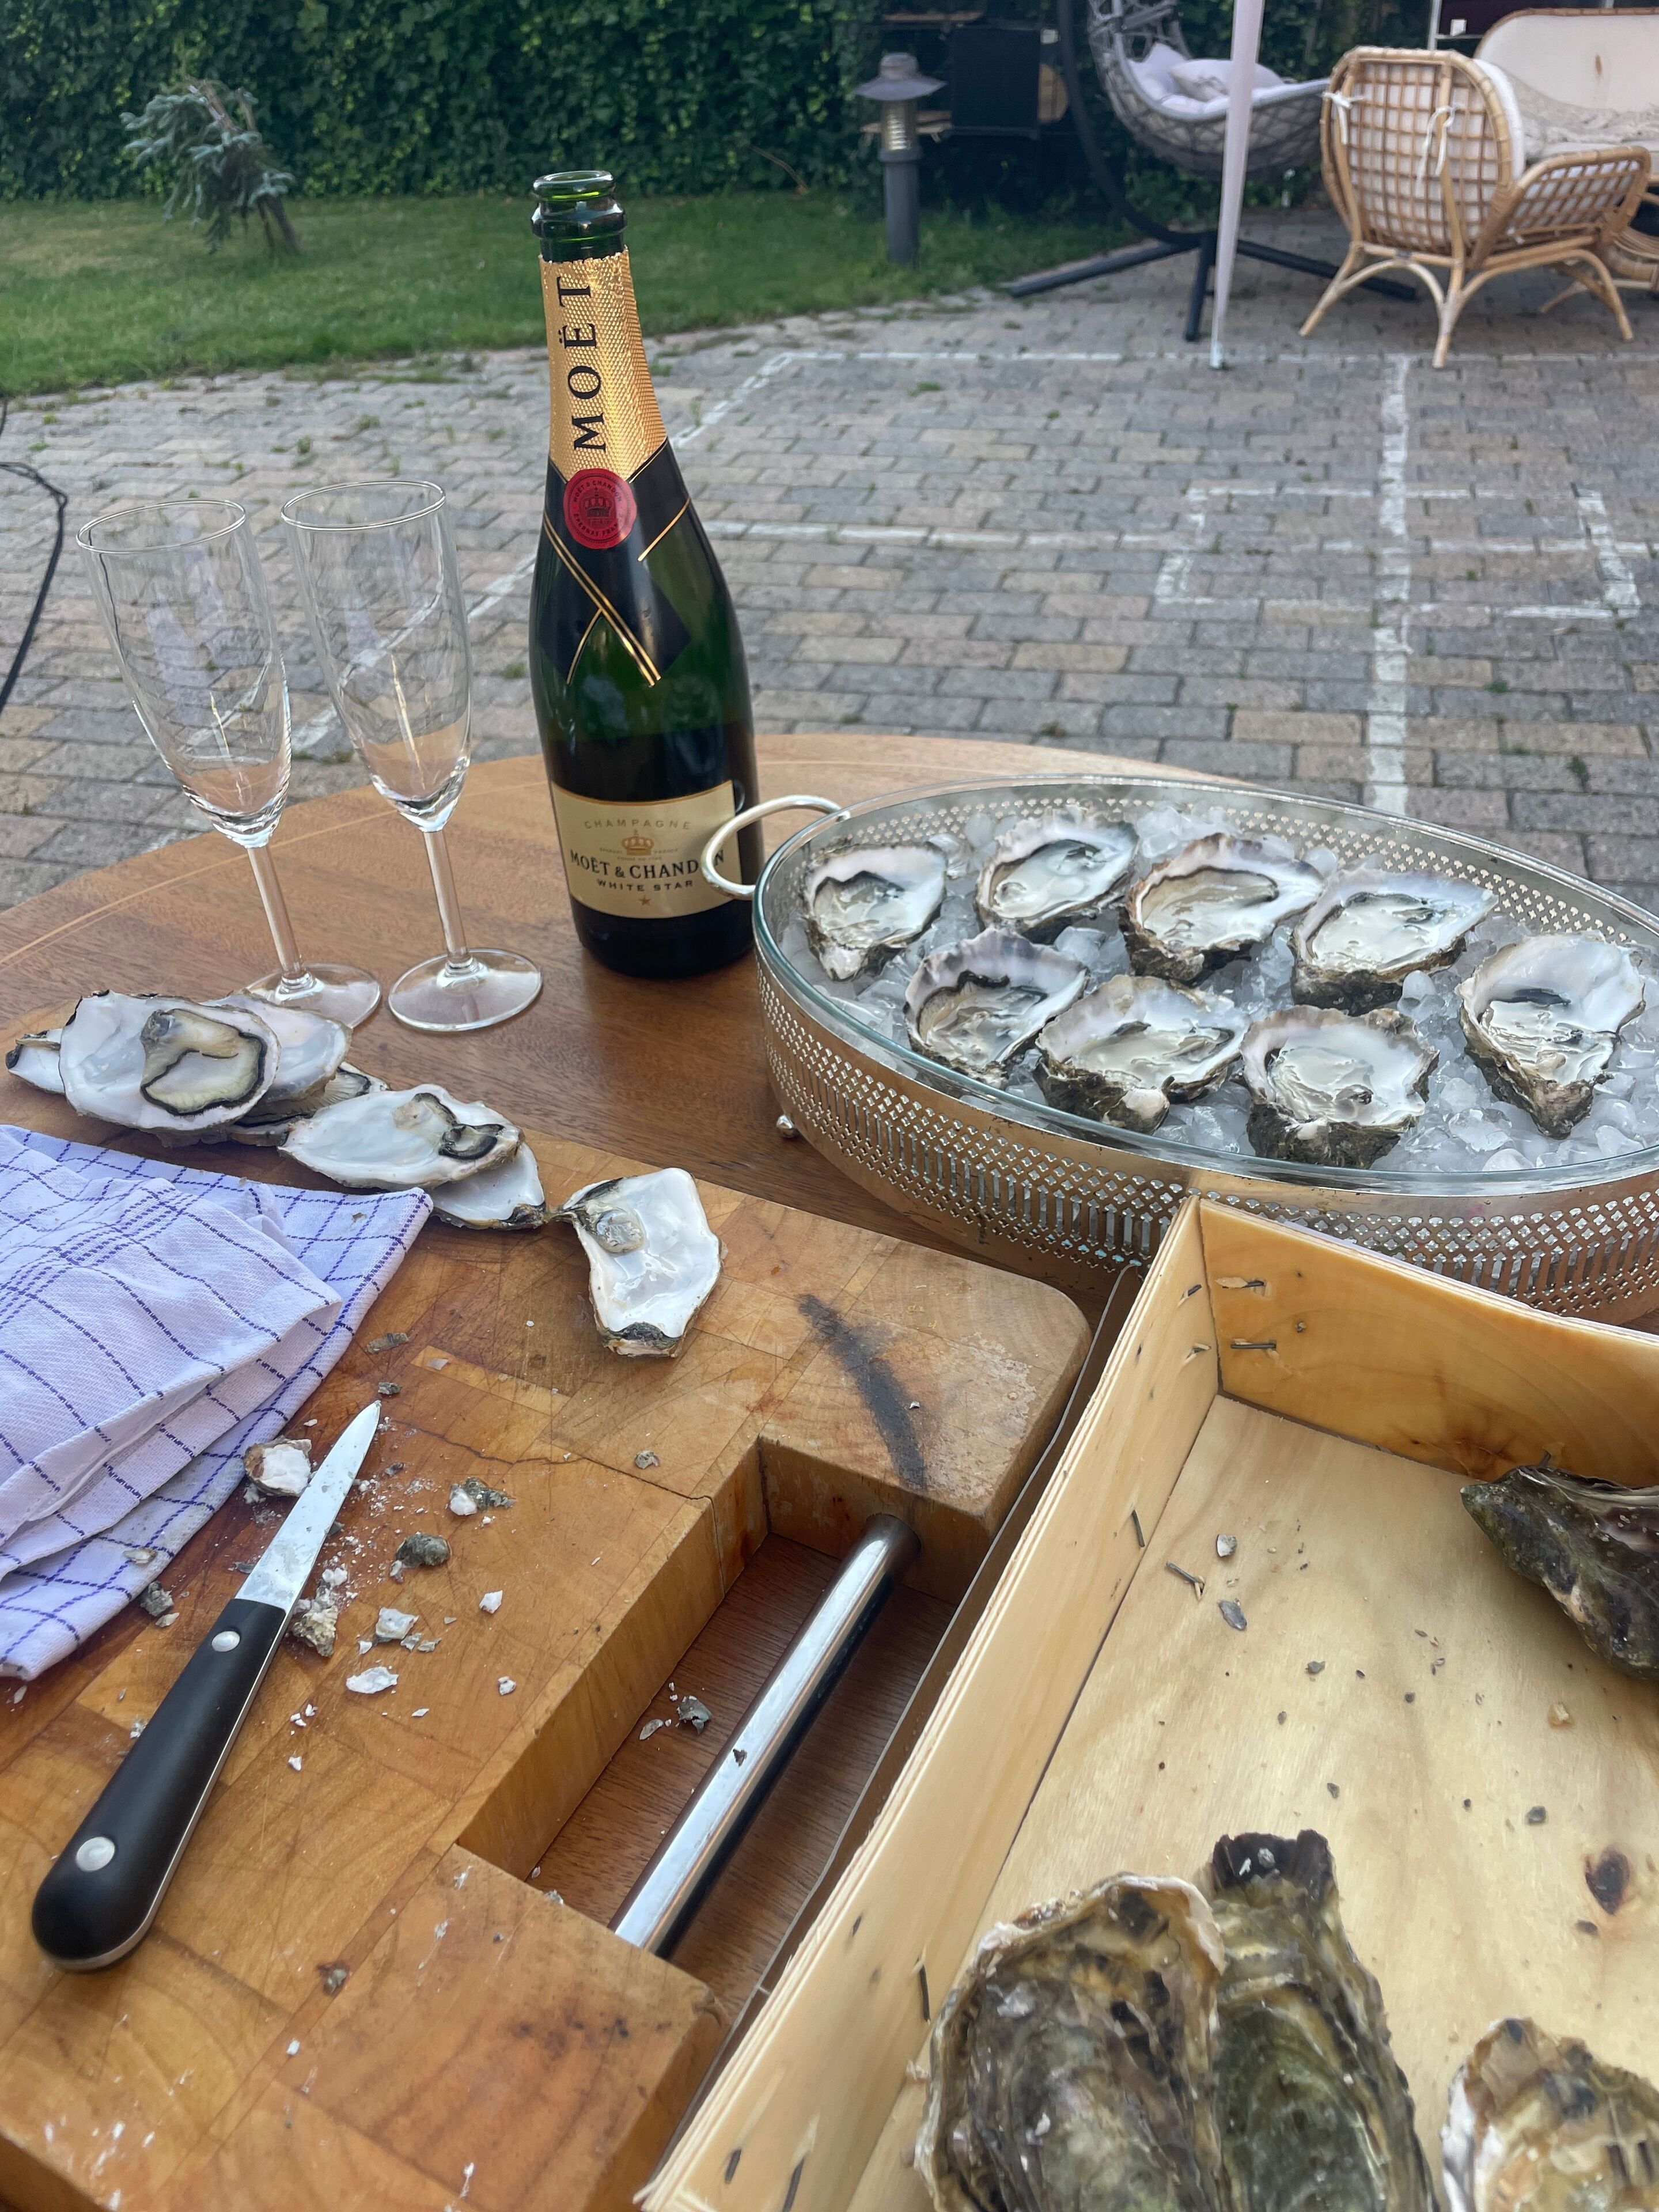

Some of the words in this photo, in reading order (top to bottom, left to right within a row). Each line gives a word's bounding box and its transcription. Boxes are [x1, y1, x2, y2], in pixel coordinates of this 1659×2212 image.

[556, 276, 606, 452] MOËT
[585, 819, 691, 830] CHAMPAGNE
[615, 866, 625, 878] &
[630, 849, 725, 879] CHANDN
[597, 878, 645, 892] WHITE
[654, 880, 693, 891] STAR
